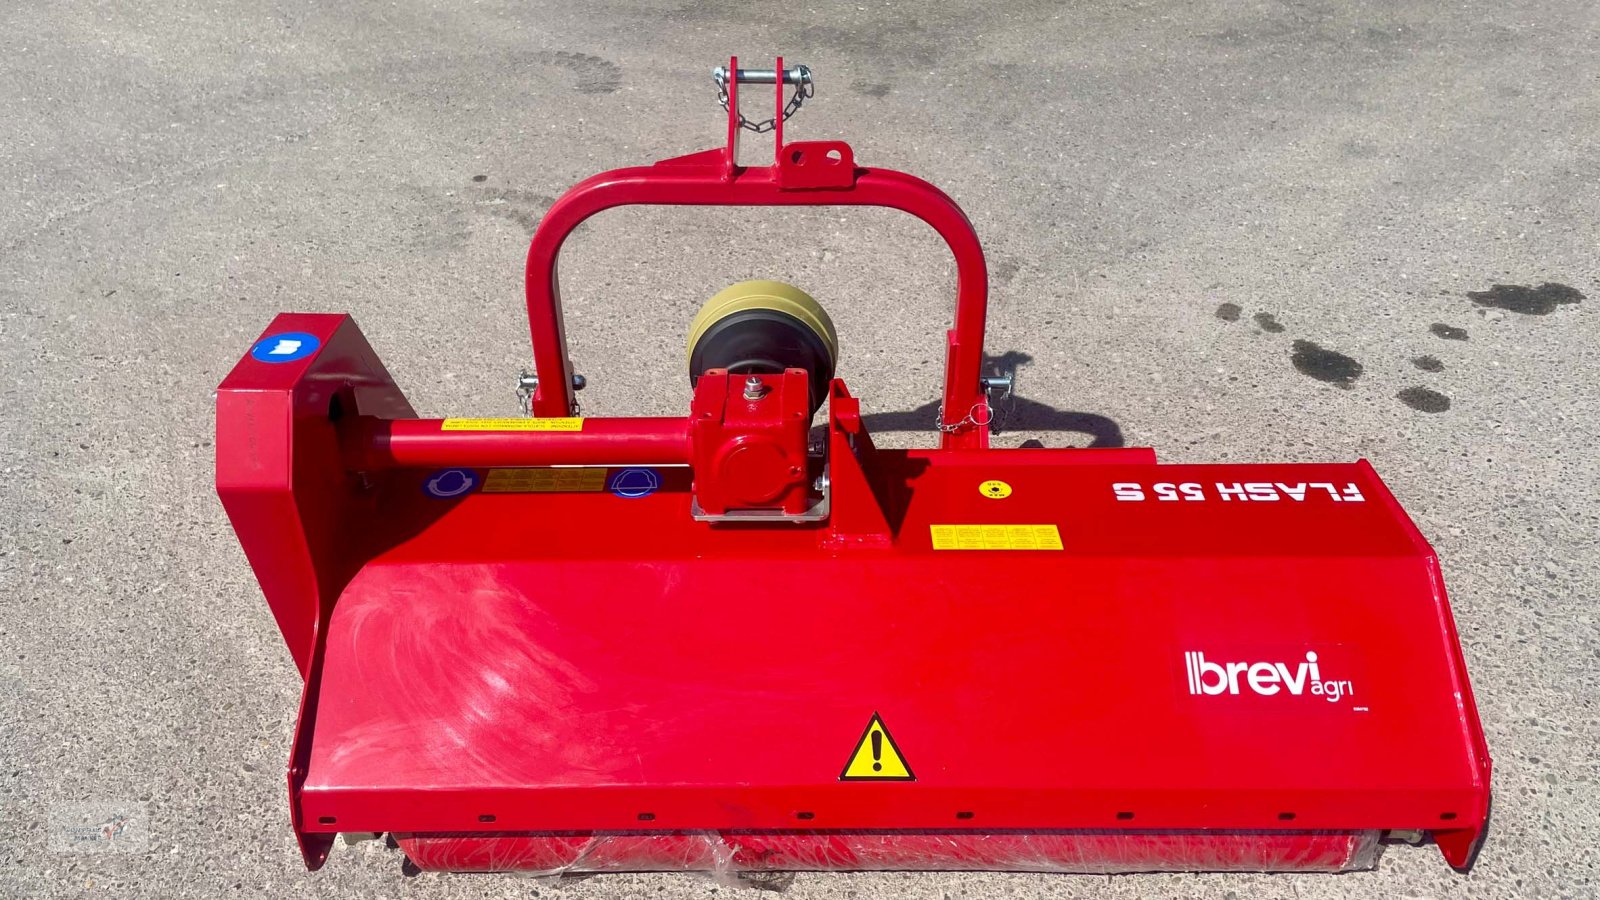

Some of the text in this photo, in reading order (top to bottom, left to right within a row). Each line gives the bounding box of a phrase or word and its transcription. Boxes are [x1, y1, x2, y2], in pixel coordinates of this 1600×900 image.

[1112, 482, 1366, 502] FLASH 55 S
[1185, 651, 1354, 703] brevi agri
